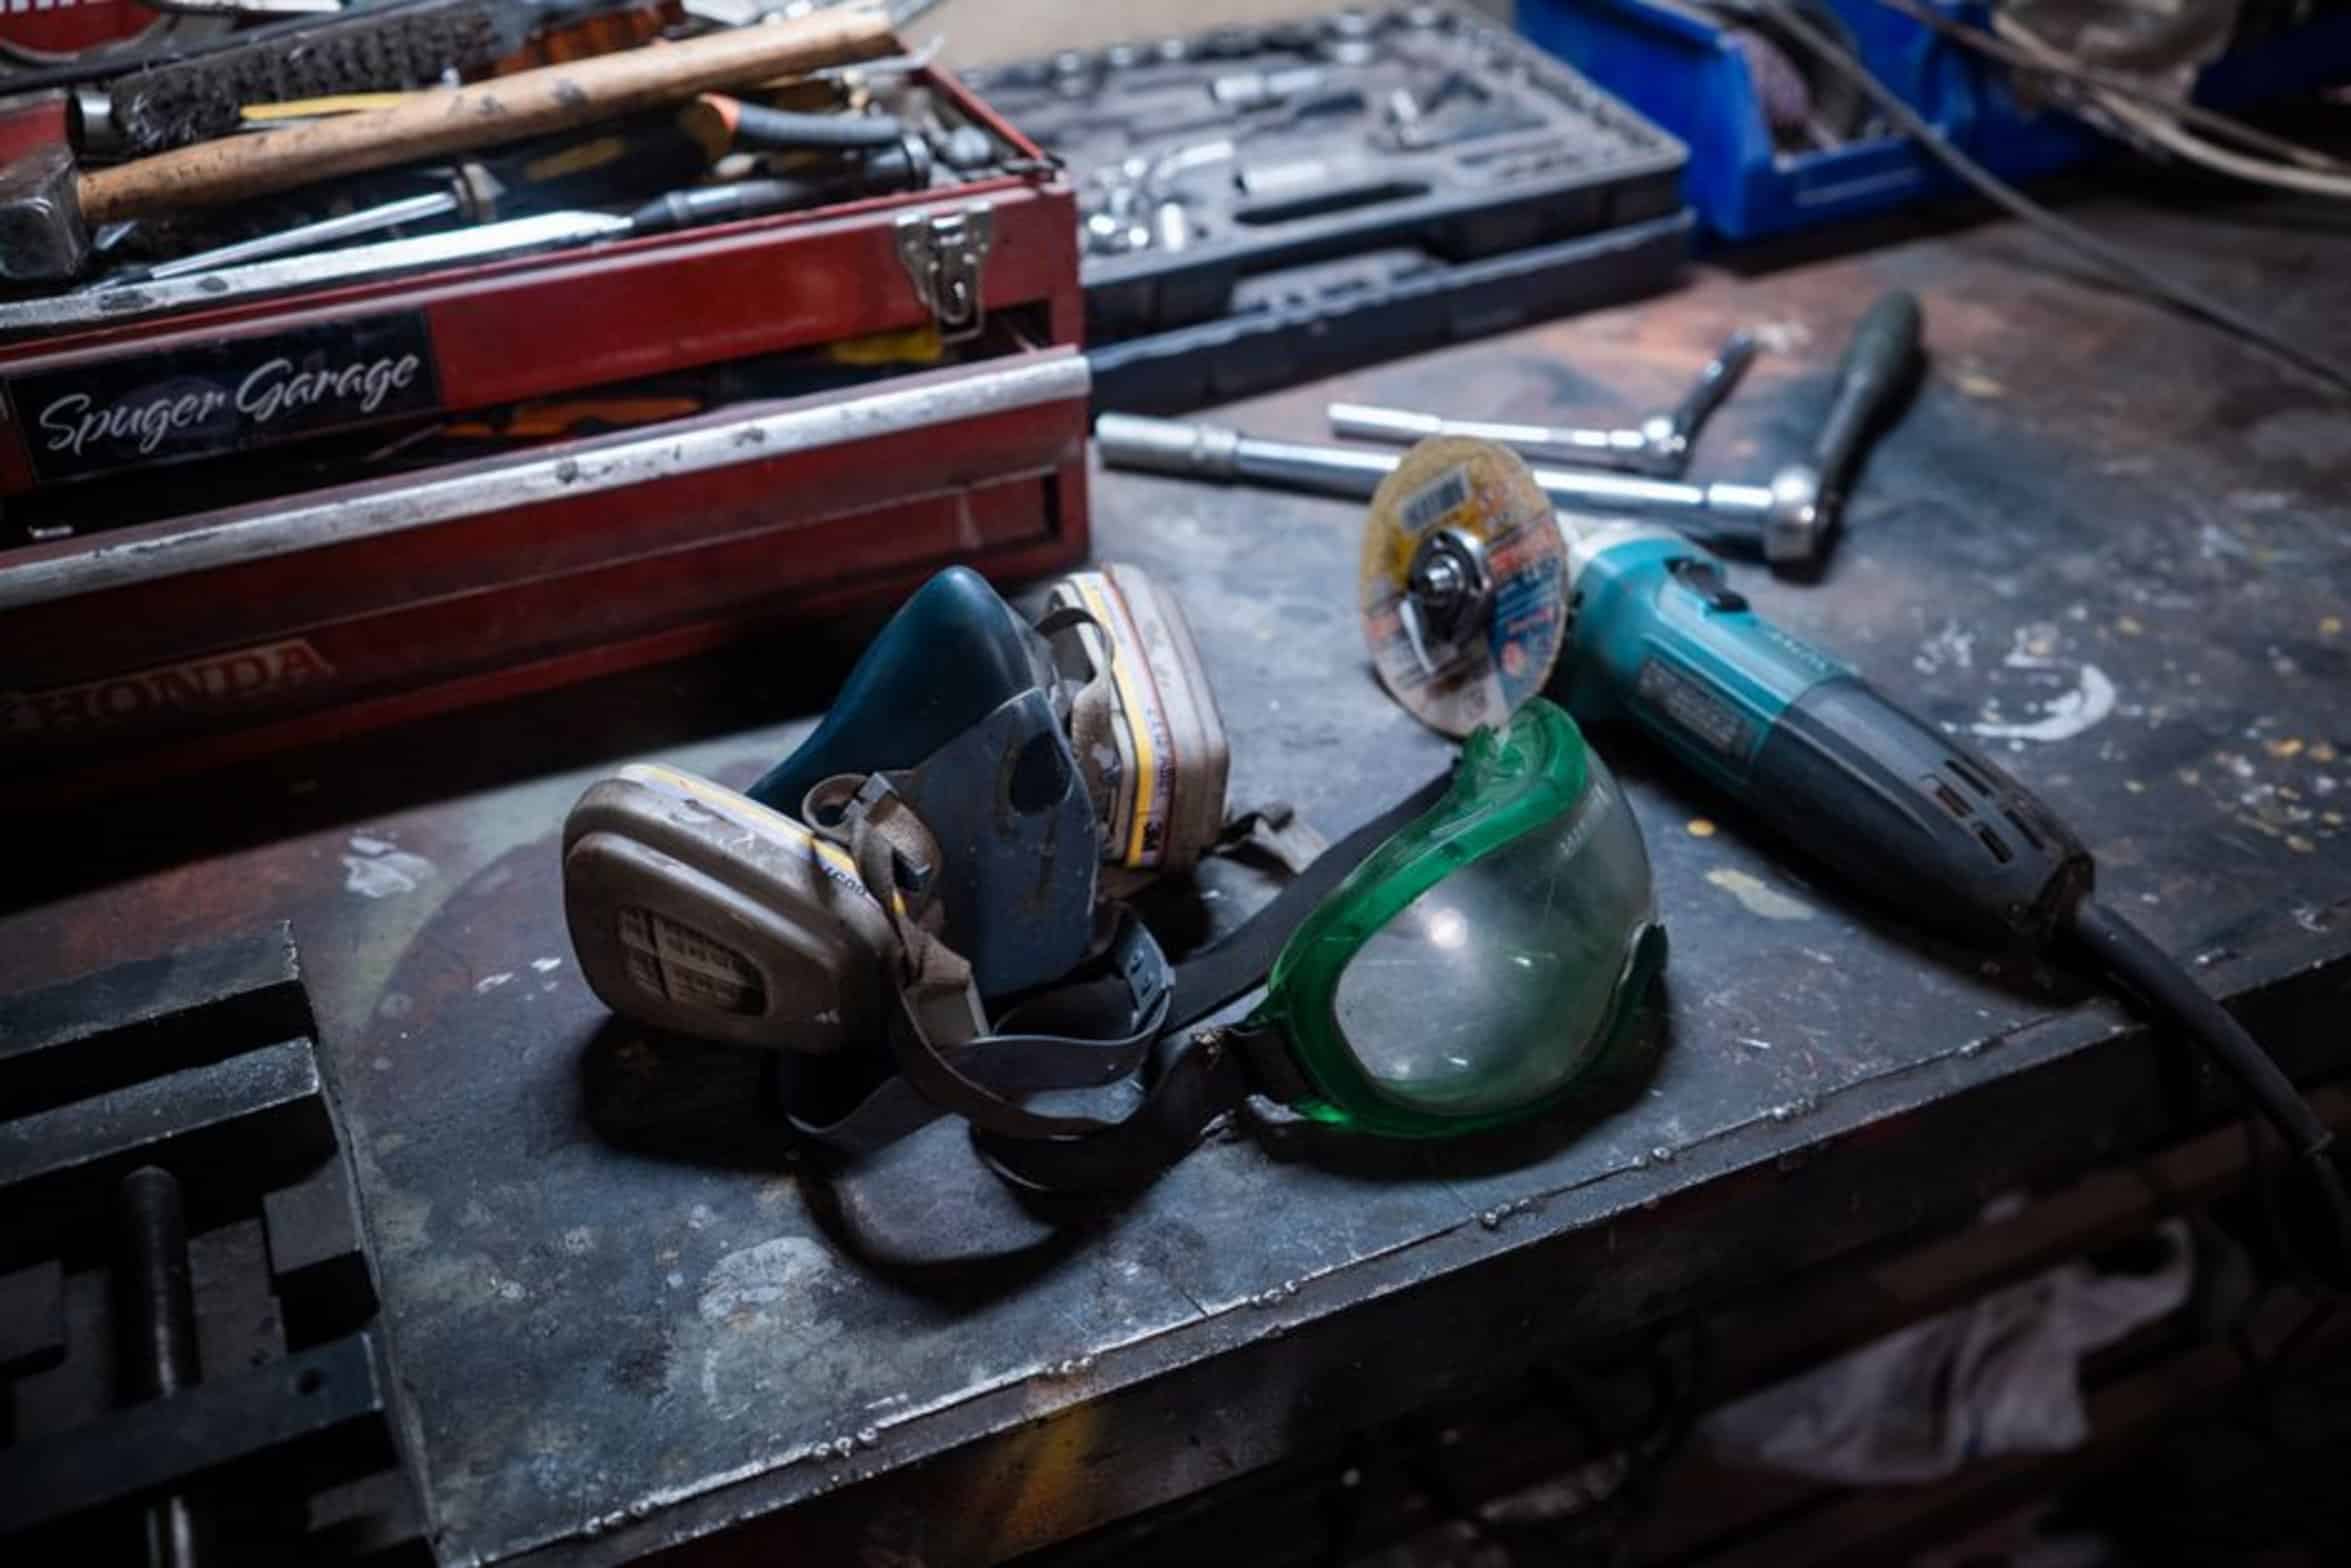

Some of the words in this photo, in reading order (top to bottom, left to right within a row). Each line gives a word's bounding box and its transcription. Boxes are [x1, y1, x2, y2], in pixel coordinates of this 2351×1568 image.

[38, 388, 226, 456] Spuger
[234, 353, 420, 423] Garage
[44, 640, 336, 726] HONDA
